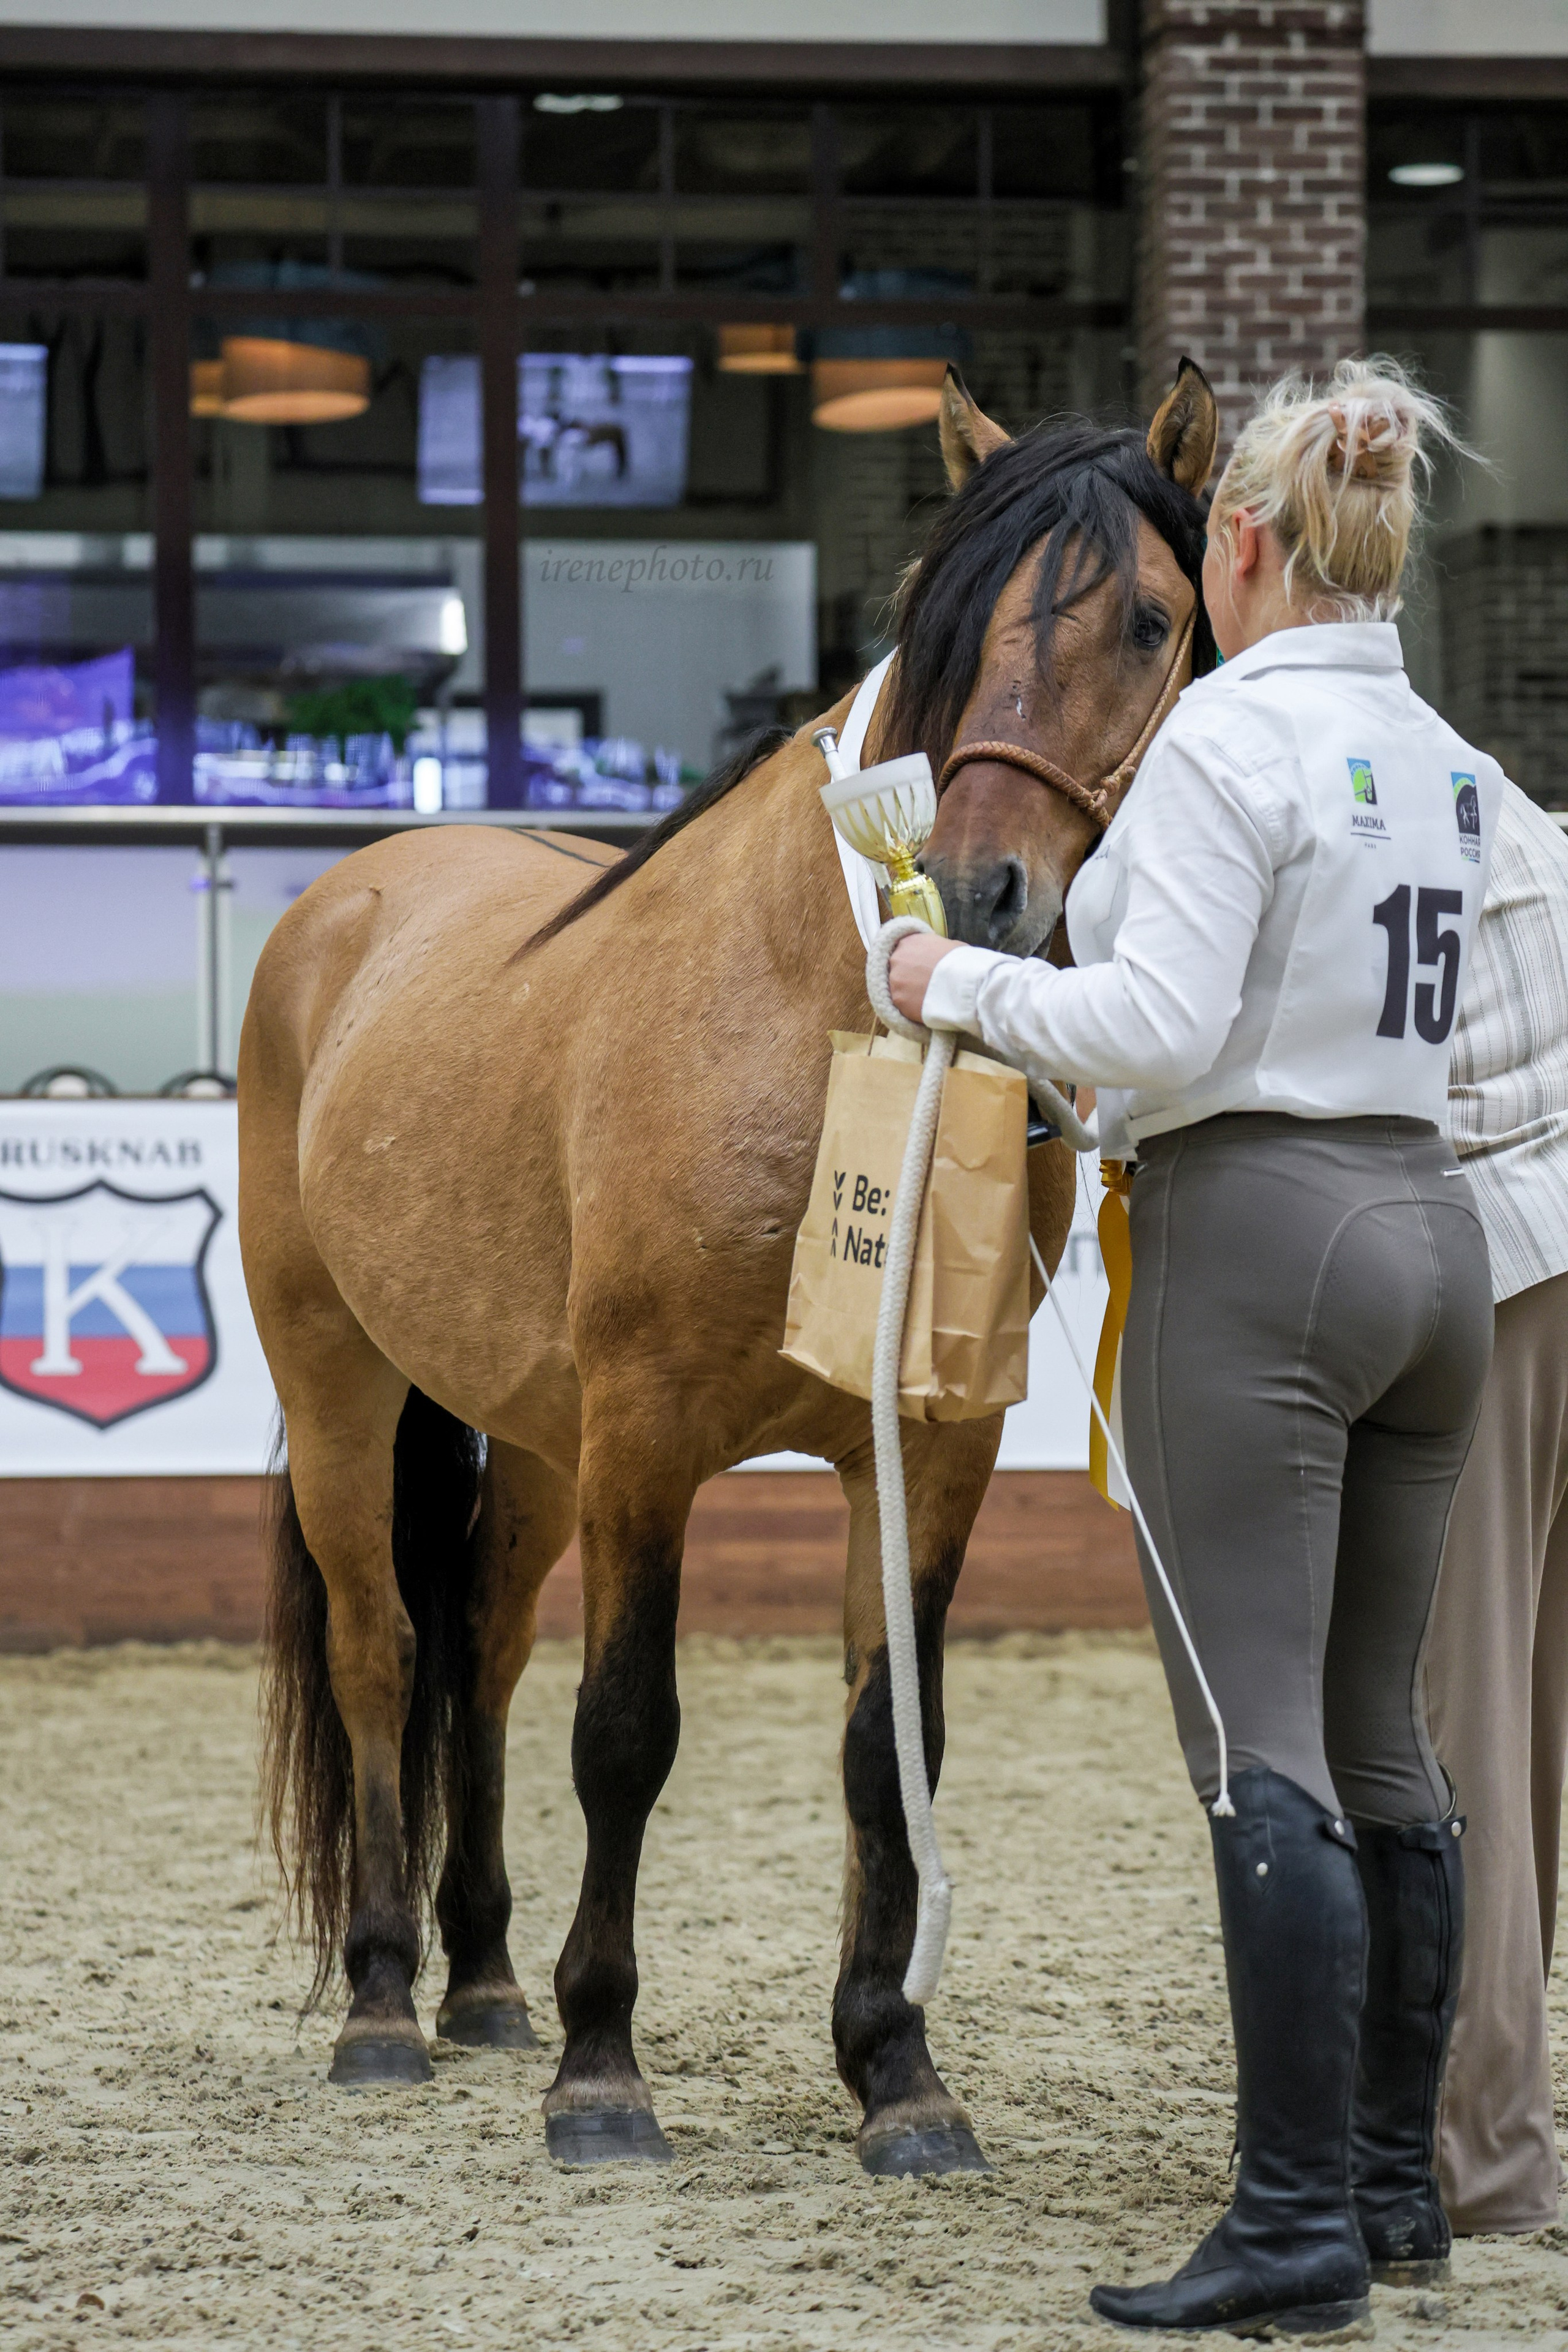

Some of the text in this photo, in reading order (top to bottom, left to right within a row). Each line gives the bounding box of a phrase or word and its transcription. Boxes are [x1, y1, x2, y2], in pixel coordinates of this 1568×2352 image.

[1352, 815, 1386, 831] MAXIMA
[1460, 835, 1480, 847] КОННАЯ
[1461, 848, 1480, 859] РОССИЯ
[1373, 883, 1463, 1045] 15
[844, 1225, 889, 1268] Nat
